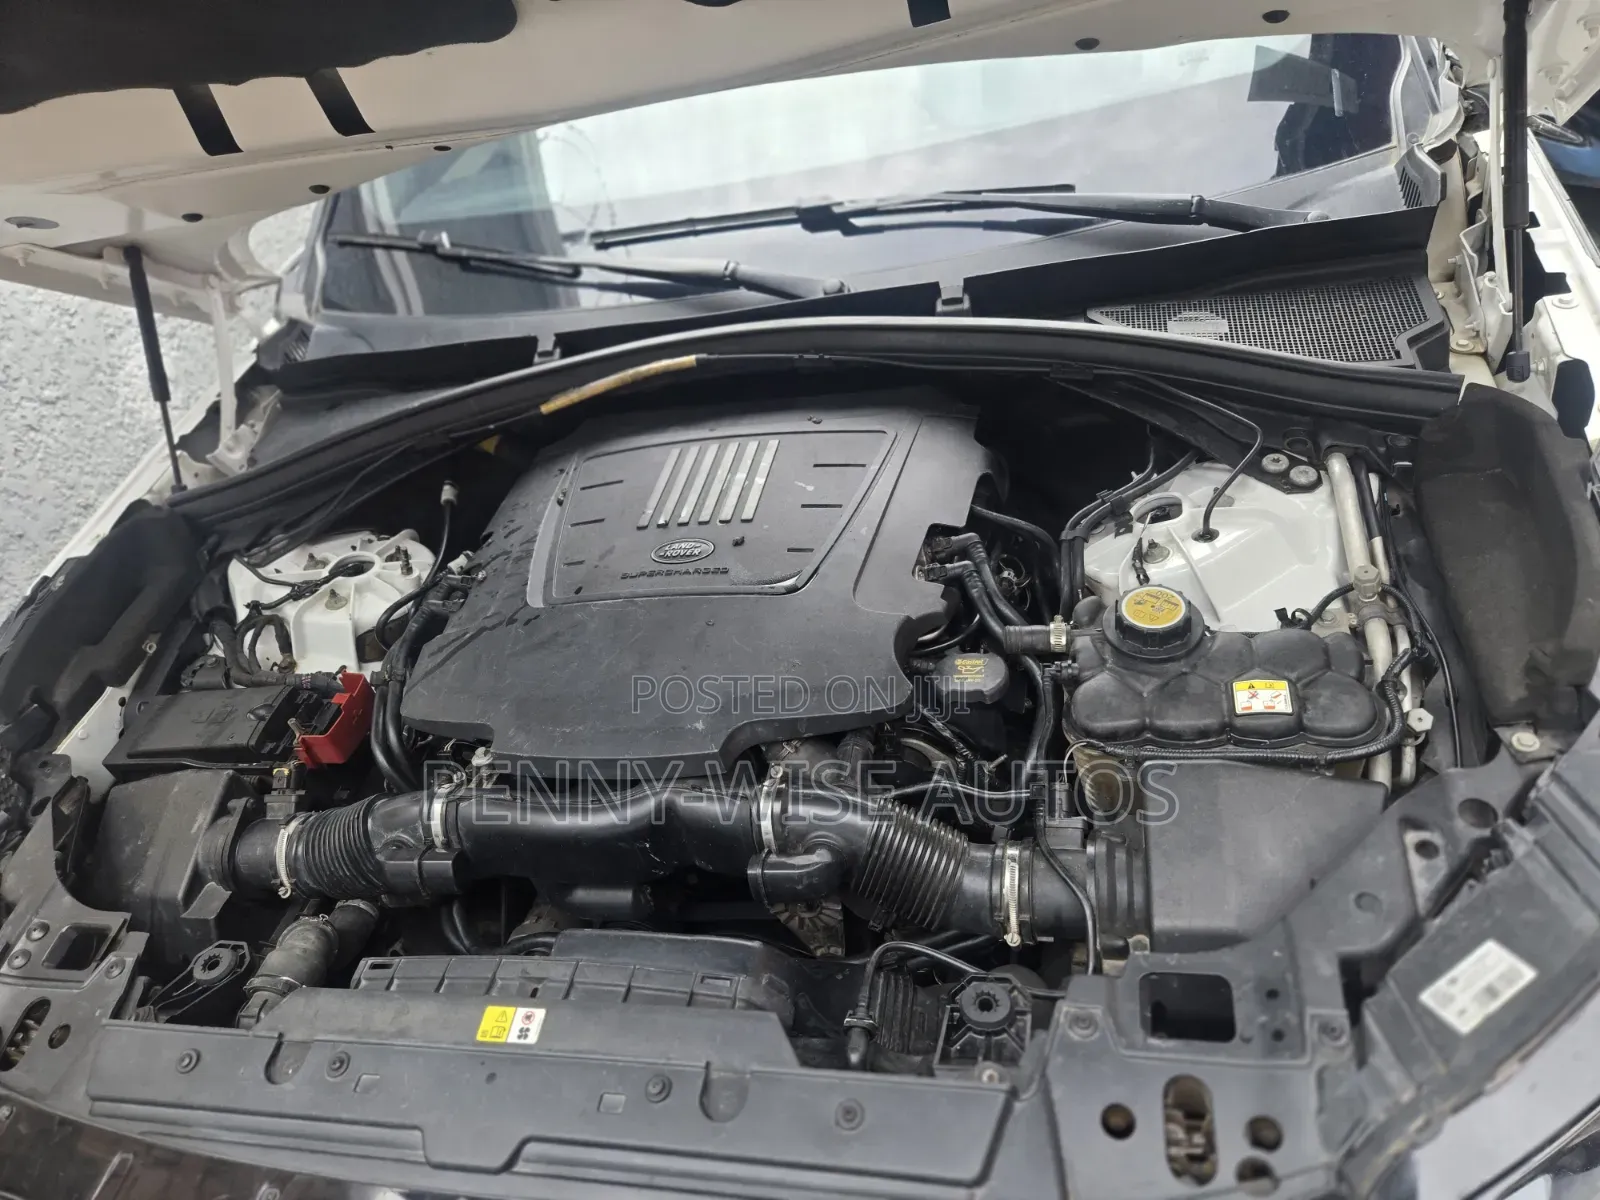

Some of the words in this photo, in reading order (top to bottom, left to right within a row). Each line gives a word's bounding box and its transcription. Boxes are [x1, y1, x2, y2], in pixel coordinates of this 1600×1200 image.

[664, 542, 694, 550] LAND
[665, 548, 702, 558] ROVER
[620, 567, 729, 579] SUPERCHARGED
